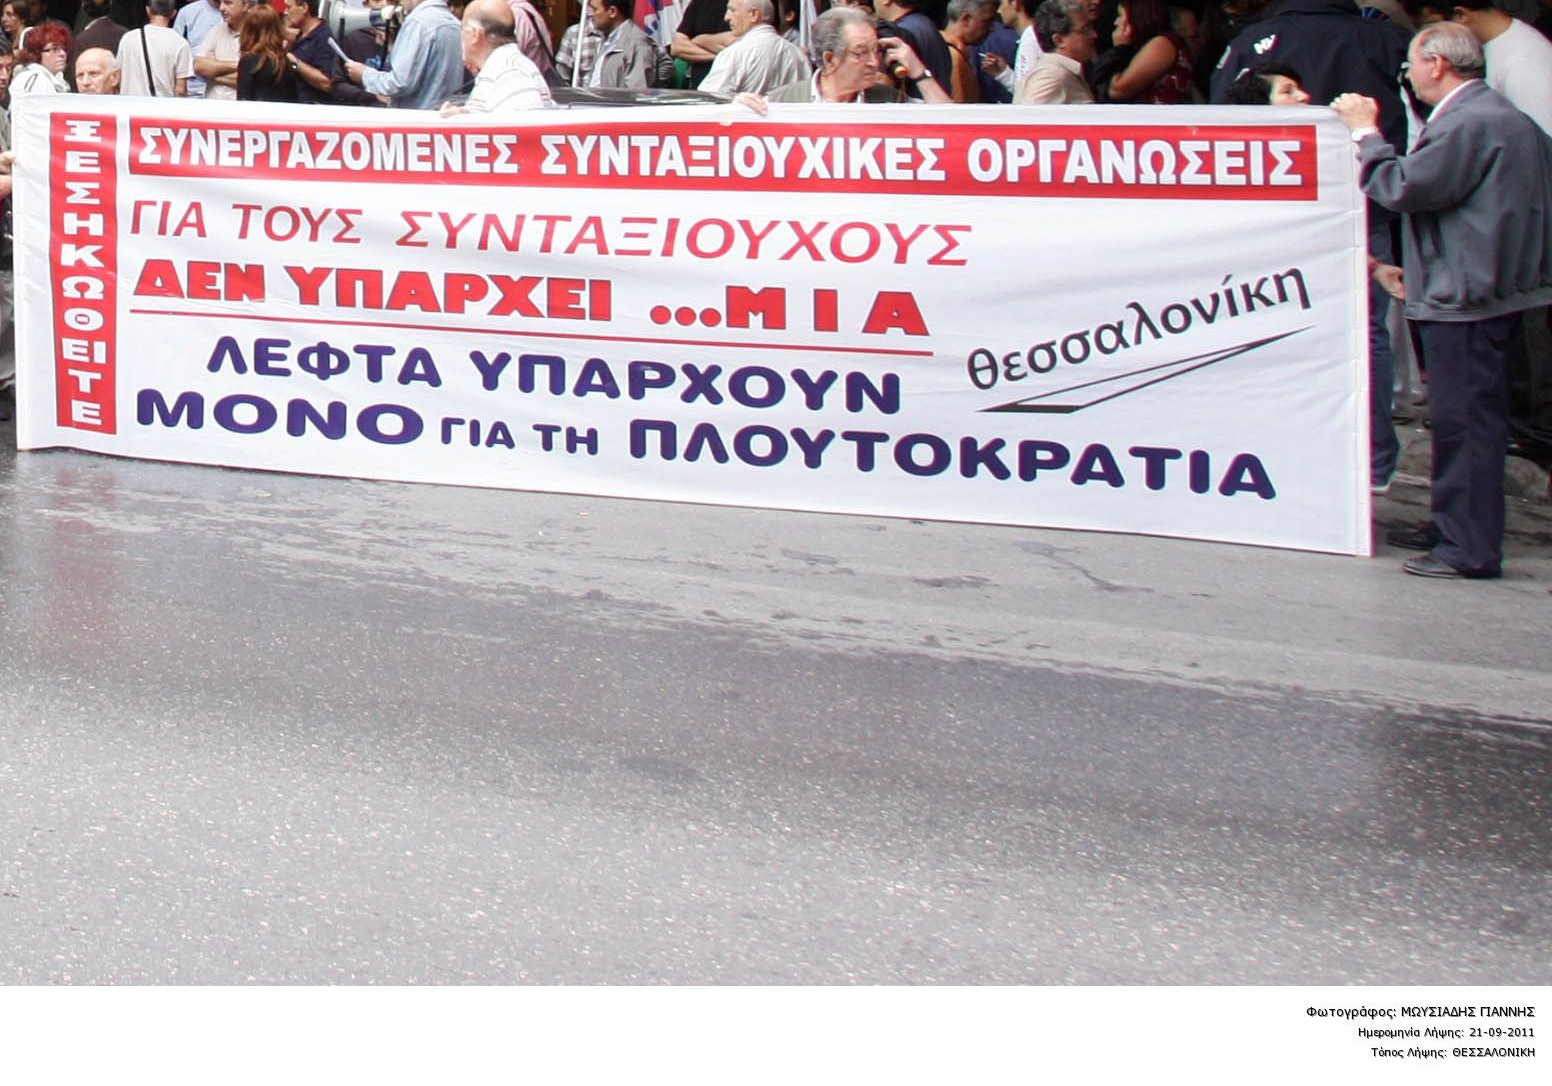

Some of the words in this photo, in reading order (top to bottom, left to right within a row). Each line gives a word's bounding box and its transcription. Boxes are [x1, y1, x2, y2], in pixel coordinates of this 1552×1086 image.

[138, 126, 519, 174] ΣΥΝΕΡΓΑΖΟΜΕΝΕΣ
[540, 134, 946, 181] ΣΥΝΤΑΞΙΟΥΧΙΚΕΣ
[968, 137, 1302, 187] ΟΡΓΑΝΩΣΕΙΣ
[129, 199, 208, 239] ΓΙΑ
[231, 202, 364, 244] ΤΟΥΣ
[397, 211, 972, 267] ΣΥΝΤΑΞΙΟΥΧΟΥΣ
[132, 258, 265, 303] ΔΕΝ
[284, 266, 612, 322] ΥΠΑΡΧΕΙ
[967, 266, 1312, 391] θεσσαλονίκη
[206, 335, 443, 388] ΛΕΦΤΑ
[469, 350, 901, 416] ΥΠΑΡΧΟΥΝ
[136, 388, 425, 445] ΜΟΝΟ
[439, 416, 516, 450] ΓΙΑ
[533, 423, 600, 457] ΤΗ
[629, 418, 1277, 500] ΠΛΟΥΤΟΚΡΑΤΙΑ
